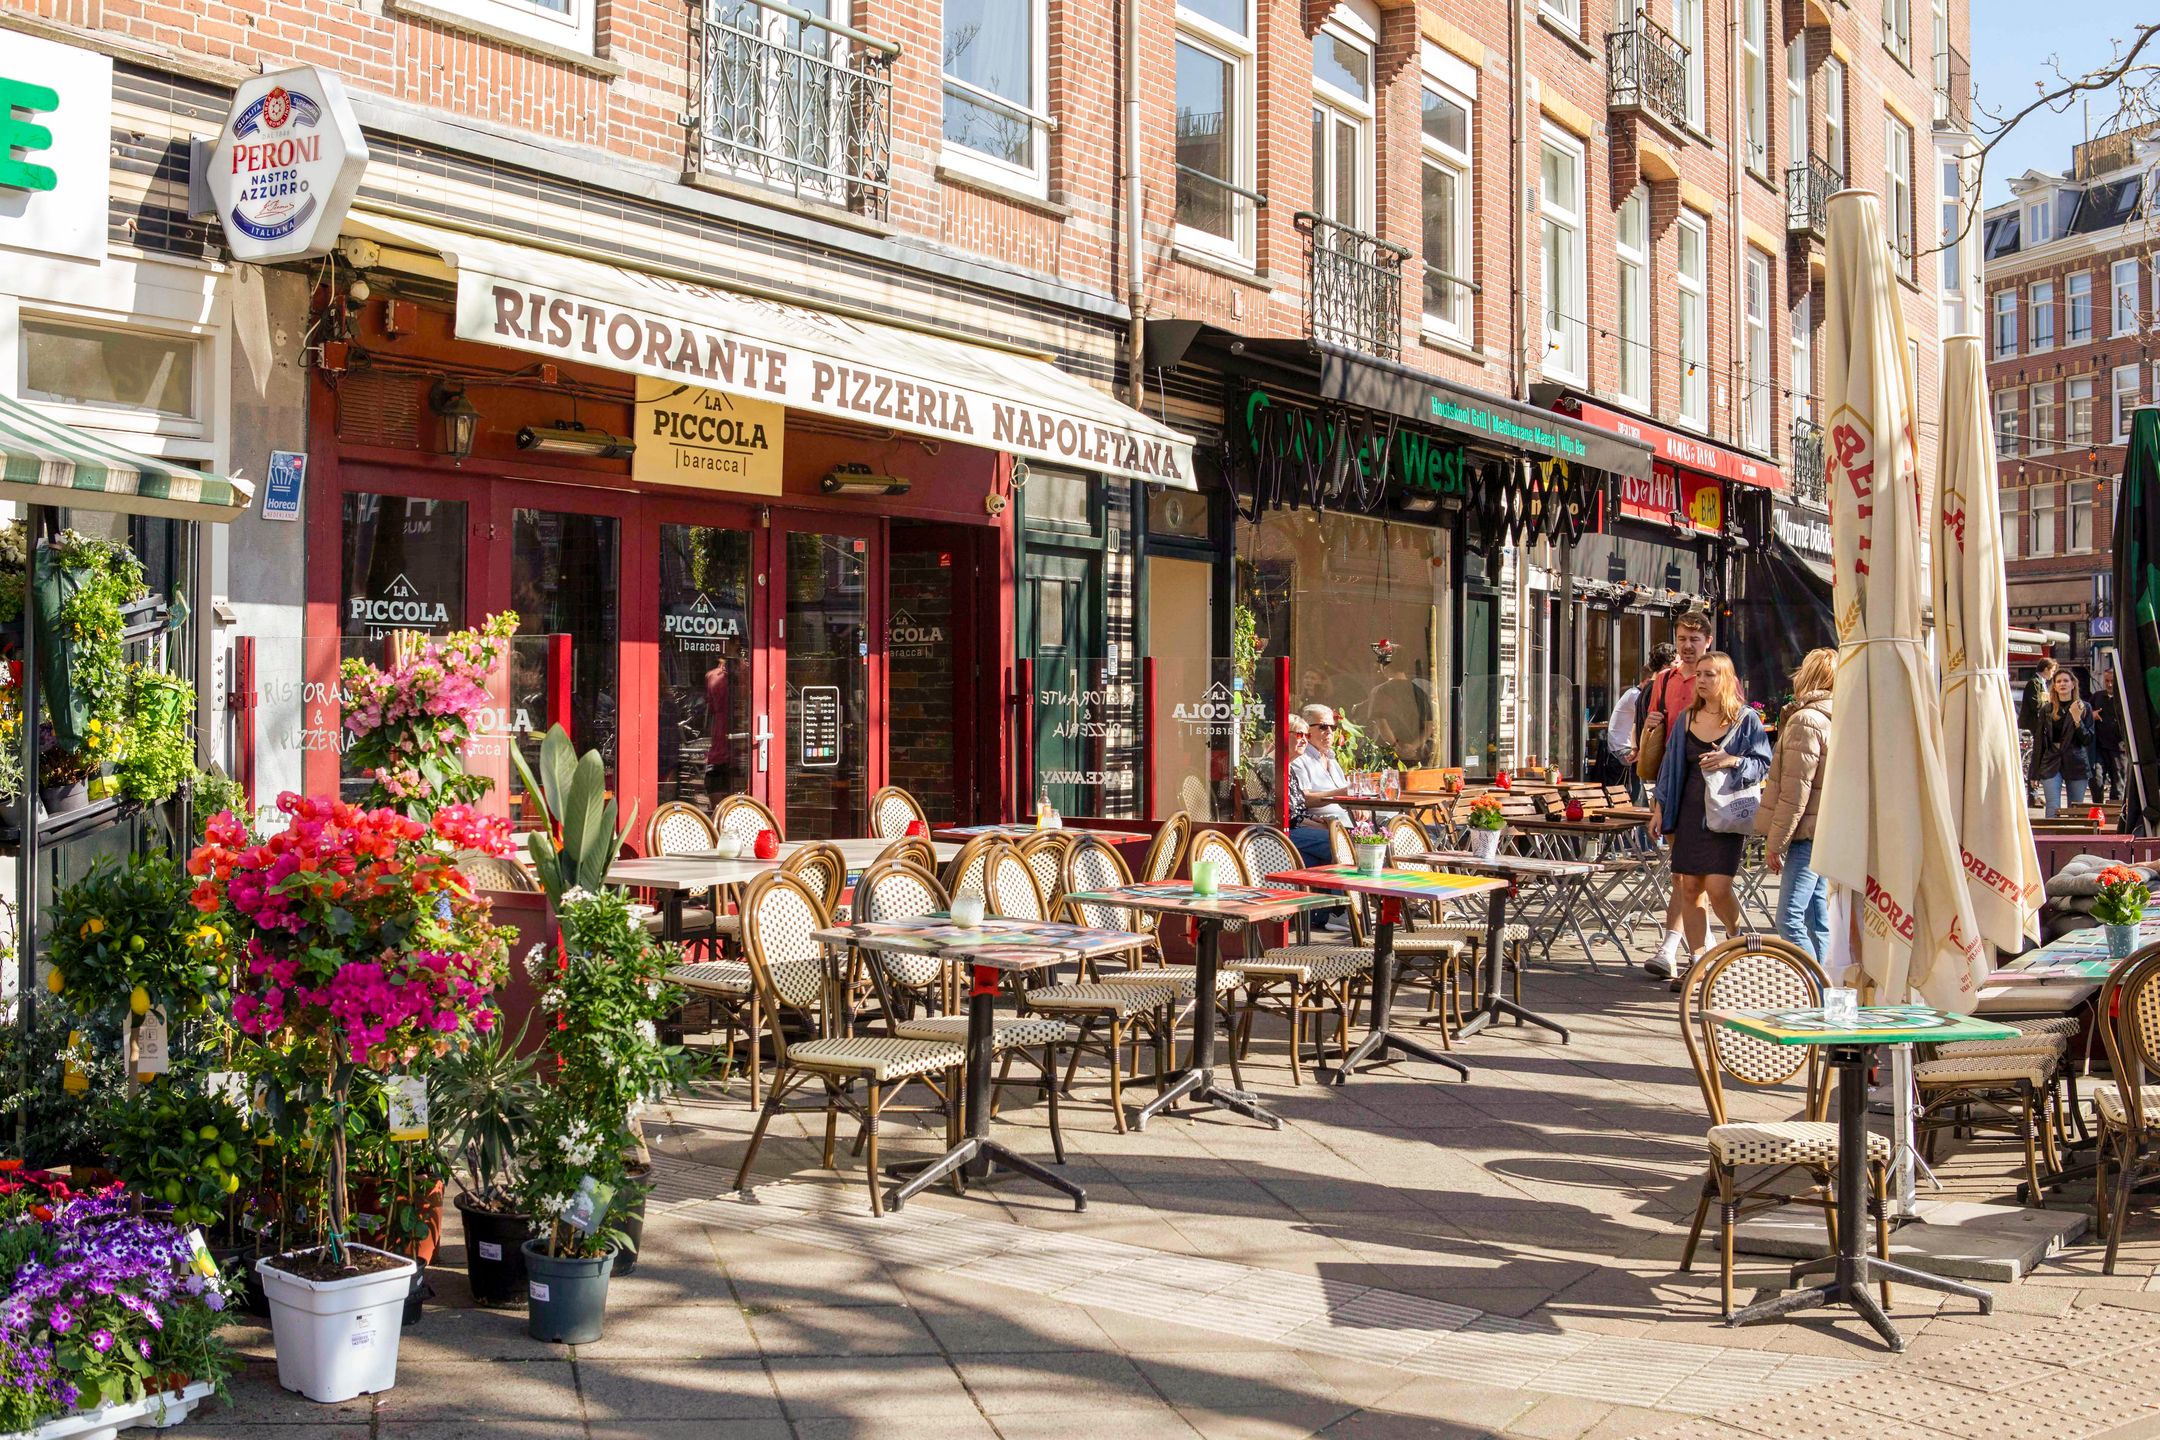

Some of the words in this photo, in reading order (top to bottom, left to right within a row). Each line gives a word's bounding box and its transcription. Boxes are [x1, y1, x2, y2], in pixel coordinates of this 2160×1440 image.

[232, 134, 320, 174] PERONI
[251, 169, 297, 185] NASTRO
[240, 180, 309, 202] AZZURRO
[251, 220, 295, 237] ITALIANA
[492, 285, 787, 395] RISTORANTE
[812, 360, 973, 436] PIZZERIA
[992, 402, 1181, 480] NAPOLETANA
[704, 396, 723, 412] LA
[653, 410, 768, 450] PICCOLA
[1431, 396, 1470, 425] Houtskool
[1471, 408, 1487, 430] Grill
[1492, 415, 1534, 443] Mediterrane
[1534, 427, 1556, 449] Mezze
[1560, 434, 1575, 456] Wijn
[1575, 441, 1586, 457] Bar
[683, 451, 739, 473] baracca
[1401, 430, 1466, 496] West
[267, 498, 296, 510] Horeca
[1648, 472, 1683, 514] TAPA
[266, 511, 295, 519] NEDERLAND
[1701, 493, 1717, 522] BAR
[1109, 528, 1117, 550] 10
[1773, 509, 1810, 549] Warme
[1810, 519, 1833, 555] bakk
[393, 586, 409, 597] LA
[351, 600, 449, 622] PICCOLA
[697, 603, 709, 614] LA
[665, 614, 739, 636] PICCOLA
[896, 616, 908, 626] LA
[684, 639, 720, 652] baracca
[264, 677, 354, 706] RISTORAN
[313, 709, 324, 726] &
[280, 727, 358, 755] PIZZERIA
[1866, 874, 1914, 941] MORE
